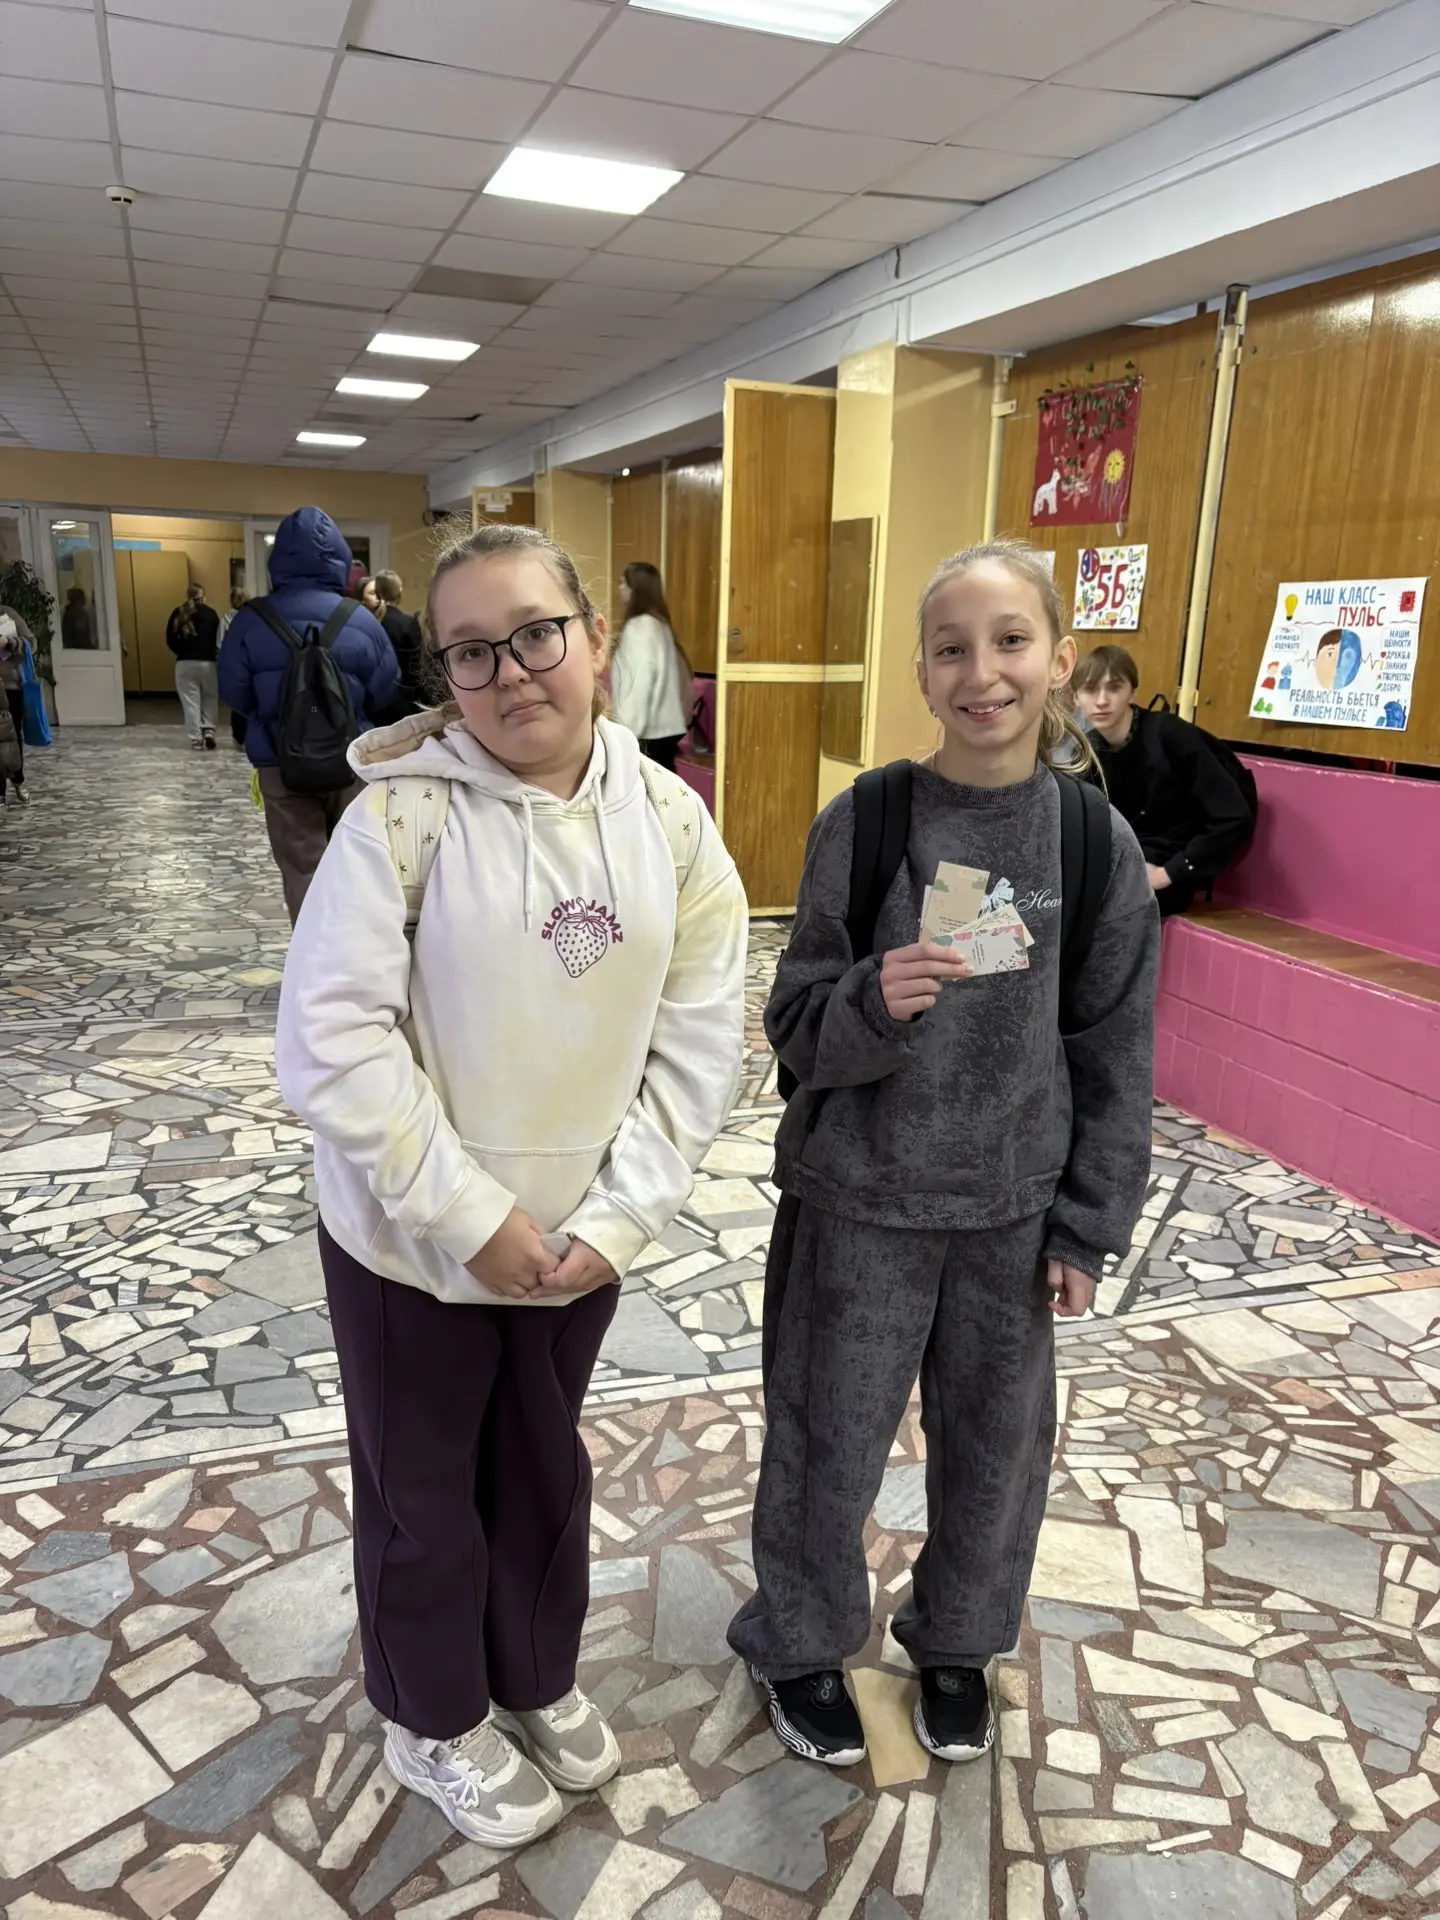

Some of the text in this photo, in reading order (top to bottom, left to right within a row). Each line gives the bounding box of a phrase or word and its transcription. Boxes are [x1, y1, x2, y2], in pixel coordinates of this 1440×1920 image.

[1305, 587, 1335, 605] НАШ
[1336, 606, 1387, 627] ПУЛЬС
[1389, 629, 1410, 639] НАШИ
[1383, 638, 1412, 648] ЦЕННОСТИ
[1385, 650, 1411, 660] ДРУЖБА
[1382, 672, 1411, 681] ТВОРЧЕСТВО
[1381, 682, 1402, 692] ДОБРО
[1289, 689, 1380, 708] РЕАЛЬНОСТЬ БЬЕТСЯ
[1292, 705, 1368, 722] В НАШЕМ ПУЛЬСЕ
[541, 898, 624, 943] SLOW JAMZ
